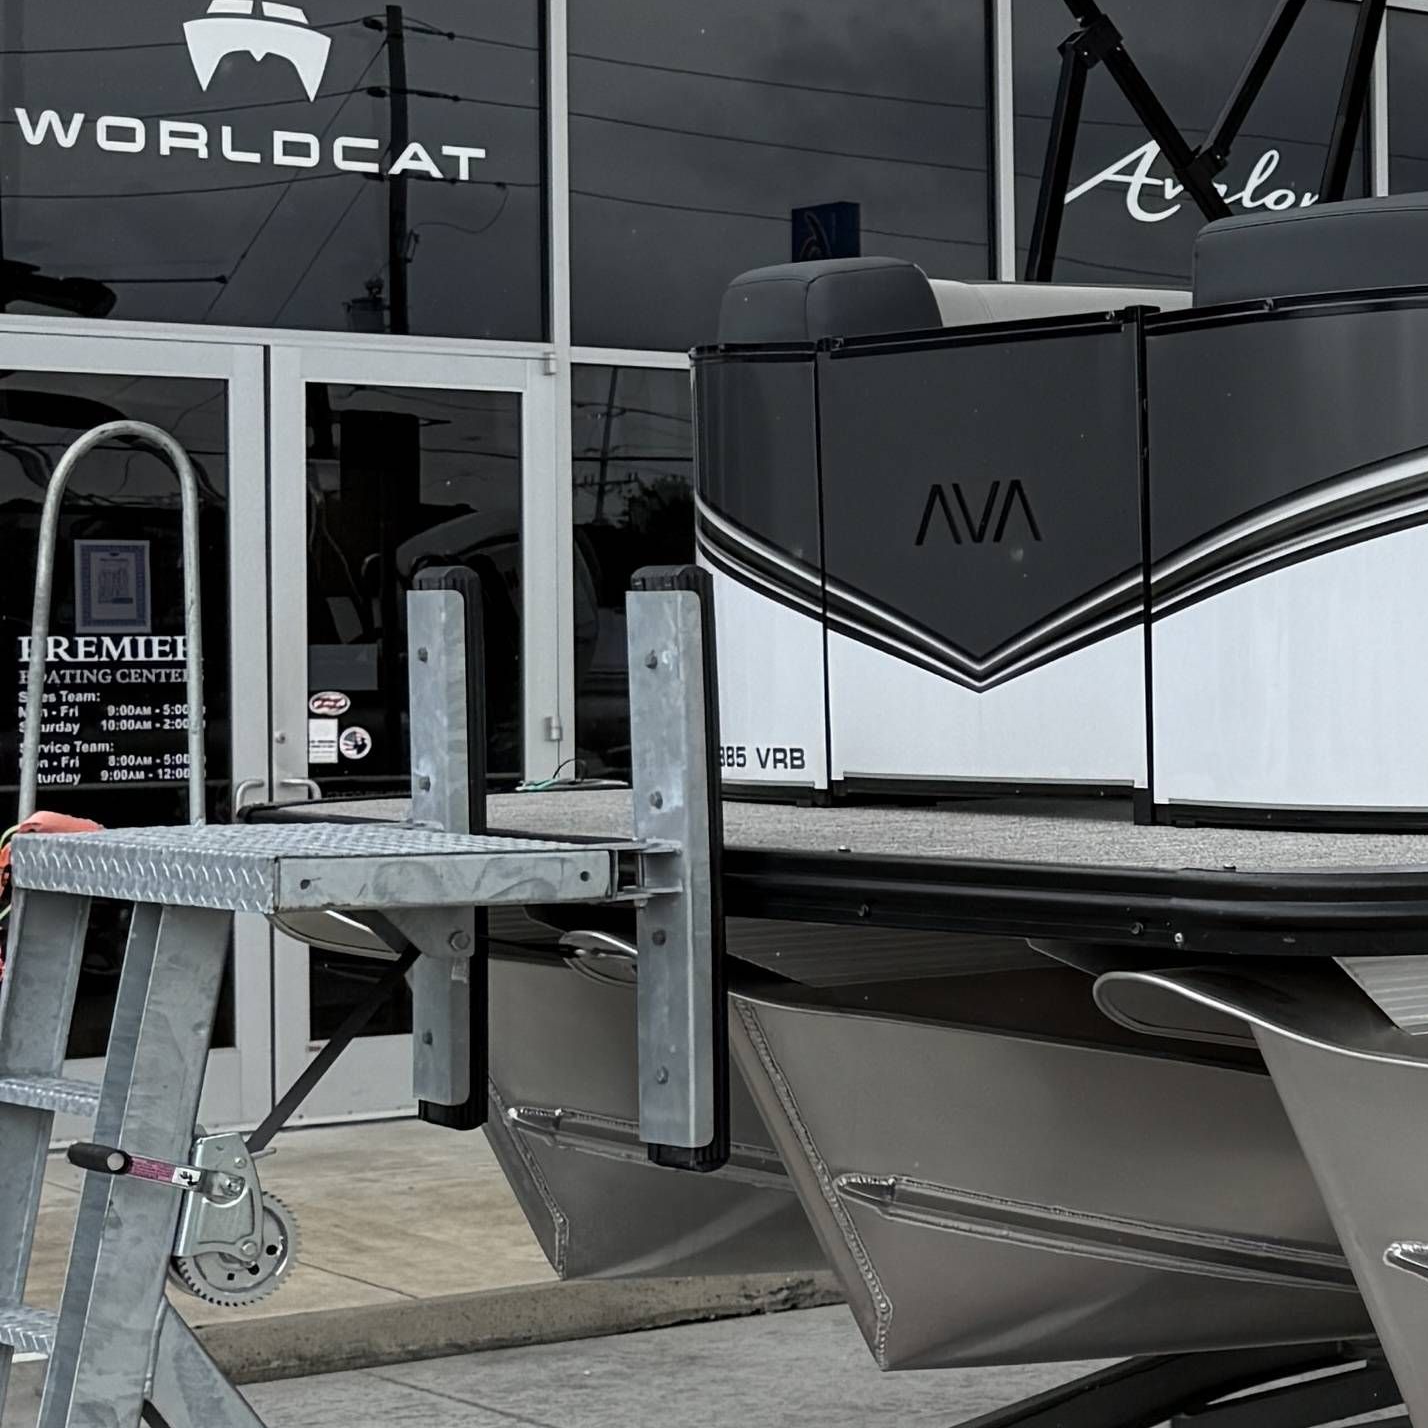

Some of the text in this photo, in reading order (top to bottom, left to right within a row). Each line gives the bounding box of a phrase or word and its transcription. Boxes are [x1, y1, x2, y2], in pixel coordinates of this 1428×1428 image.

[14, 107, 486, 181] WORLDCAT
[915, 479, 1042, 546] AVA
[19, 669, 112, 684] ATING
[60, 690, 100, 703] Team:
[60, 705, 79, 717] Fri
[73, 740, 114, 753] Team:
[61, 755, 79, 768] Fri
[756, 748, 805, 769] VRB
